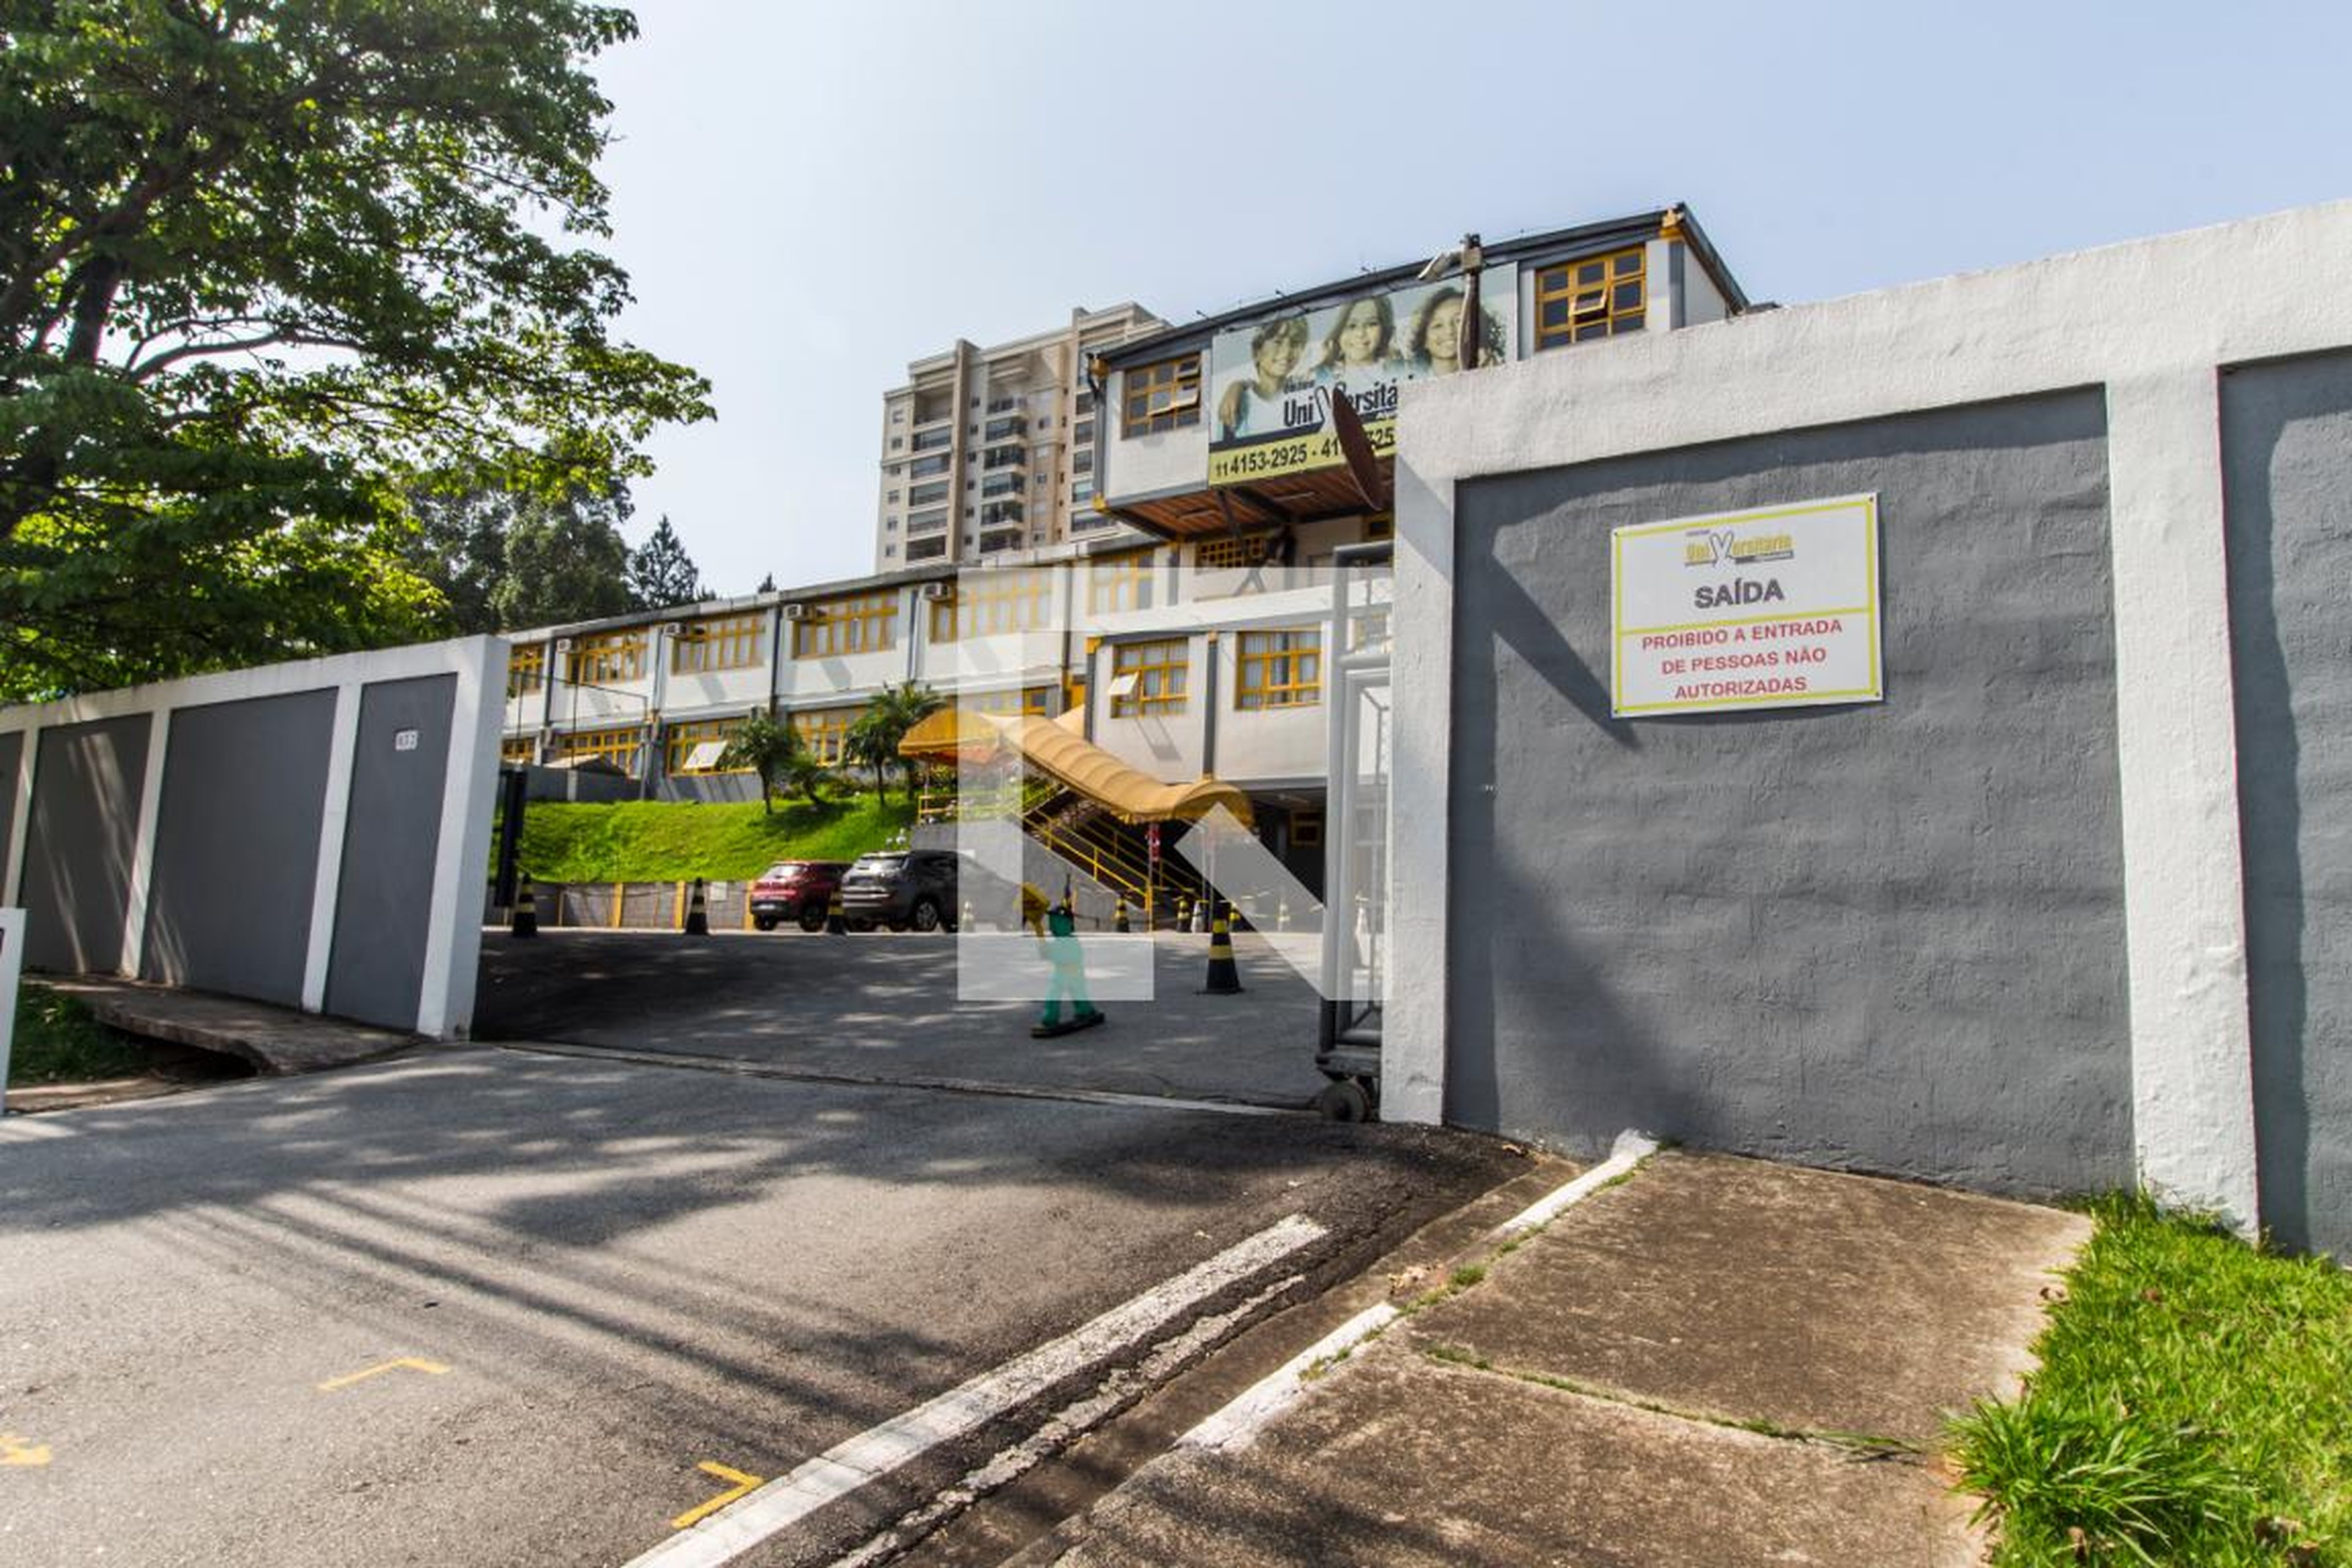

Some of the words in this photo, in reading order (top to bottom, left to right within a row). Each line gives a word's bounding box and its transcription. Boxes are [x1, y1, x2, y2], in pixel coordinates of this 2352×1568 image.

[1231, 443, 1307, 475] 4153-2925
[1695, 577, 1785, 608] SAÍDA
[1642, 629, 1728, 650] PROIBIDO
[1735, 628, 1746, 642] A
[1752, 619, 1842, 640] ENTRADA
[1662, 659, 1686, 675] DE
[1691, 651, 1779, 671] PESSOAS
[1785, 644, 1827, 665] NÃO
[1675, 676, 1807, 699] AUTORIZADAS
